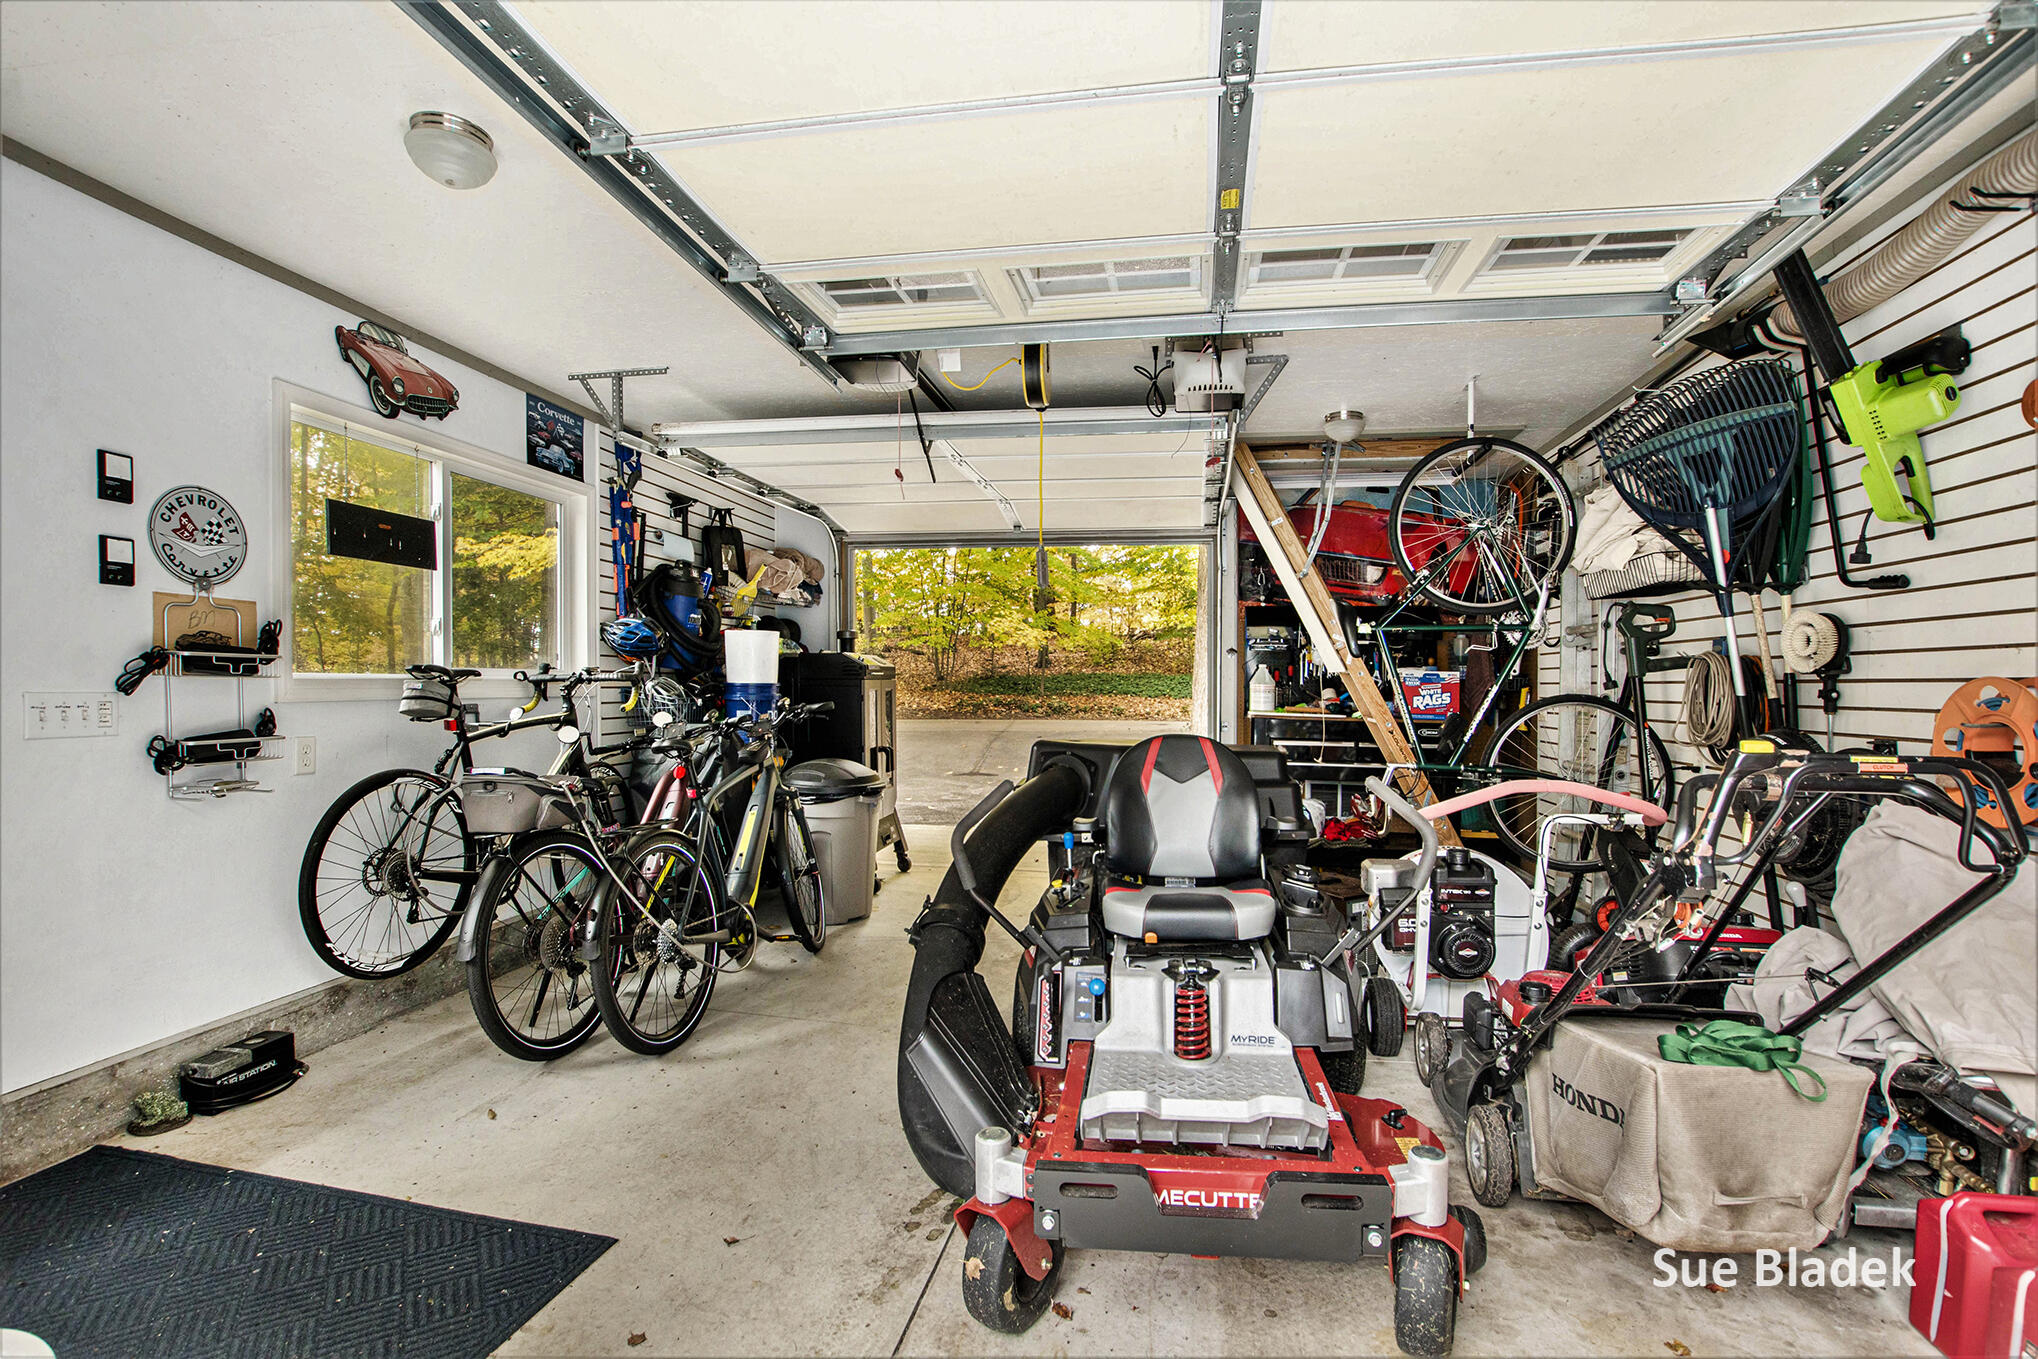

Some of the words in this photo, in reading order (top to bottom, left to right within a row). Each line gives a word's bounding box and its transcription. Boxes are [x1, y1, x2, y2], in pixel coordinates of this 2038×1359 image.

[537, 401, 575, 426] Corvette
[159, 493, 240, 535] CHEVROLET
[161, 543, 238, 578] Corvette
[1412, 692, 1452, 711] RAGS
[1418, 688, 1442, 696] WHITE
[239, 1059, 277, 1081] STATION
